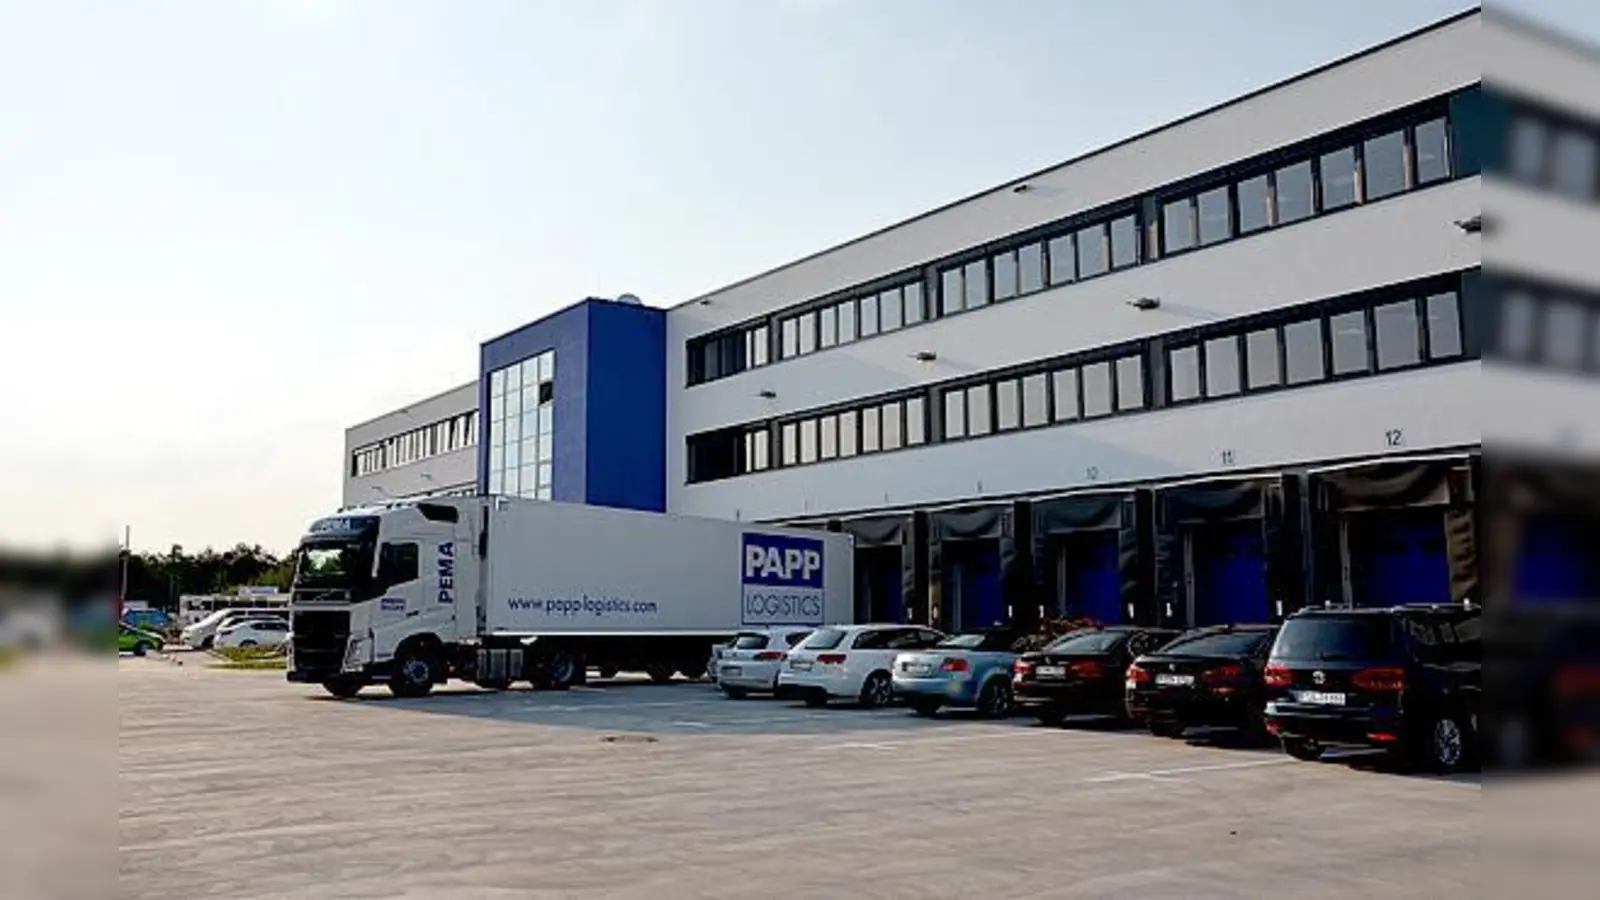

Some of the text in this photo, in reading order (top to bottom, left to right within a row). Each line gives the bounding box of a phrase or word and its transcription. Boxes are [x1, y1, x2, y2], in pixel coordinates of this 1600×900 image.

[1385, 429, 1402, 446] 12
[438, 542, 454, 604] PEMA
[745, 544, 820, 580] PAPP
[746, 594, 820, 617] LOGISTICS
